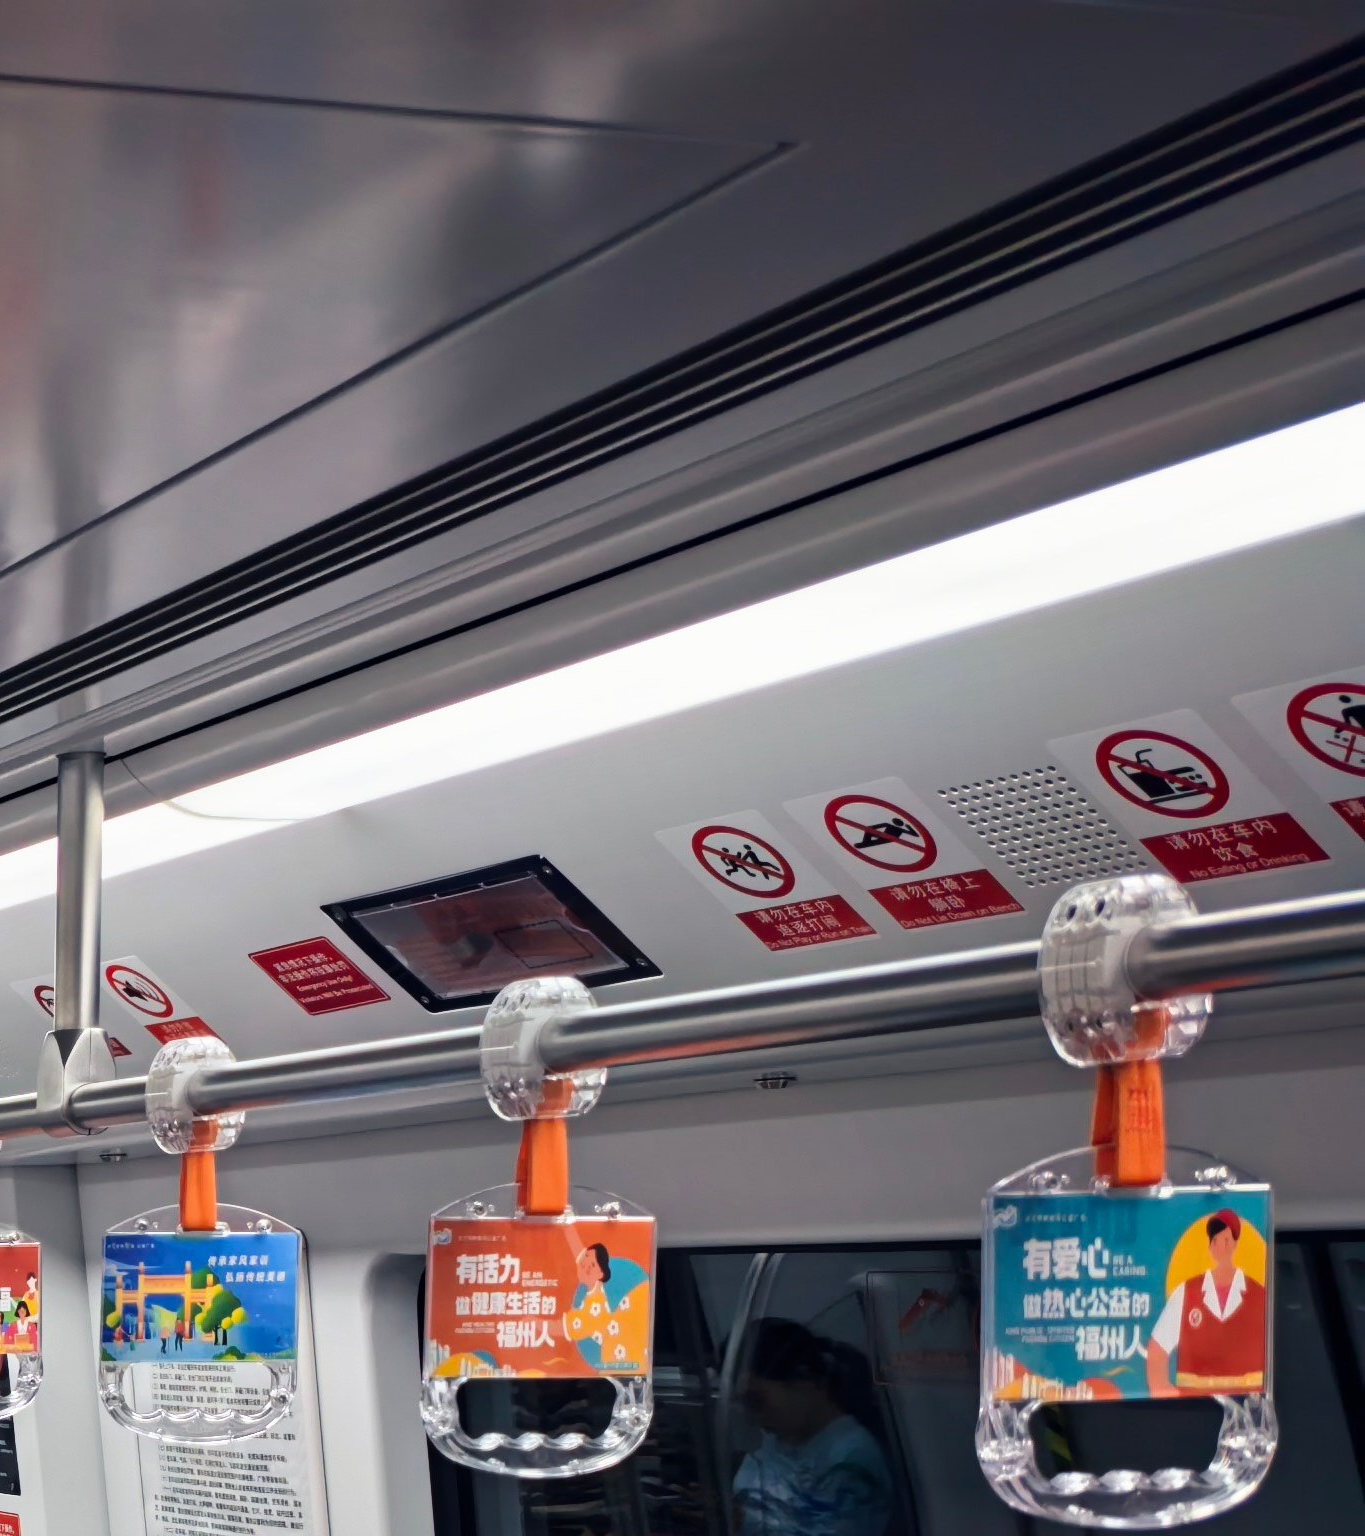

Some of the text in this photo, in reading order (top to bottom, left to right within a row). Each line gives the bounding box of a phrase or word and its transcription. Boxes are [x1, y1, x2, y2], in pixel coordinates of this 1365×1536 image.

[1166, 818, 1278, 850] 请勿在车内
[1211, 841, 1259, 862] 饮食
[1189, 868, 1208, 879] No
[889, 875, 981, 902] 请勿在椅上
[753, 899, 835, 924] 请勿在车内
[456, 1253, 521, 1285] 有活力
[1023, 1237, 1109, 1281] 有爱心
[455, 1291, 557, 1316] 做健康生活的
[1023, 1287, 1150, 1320] 做热心公益的
[496, 1321, 556, 1348] 福州人
[1075, 1324, 1148, 1361] 福州人
